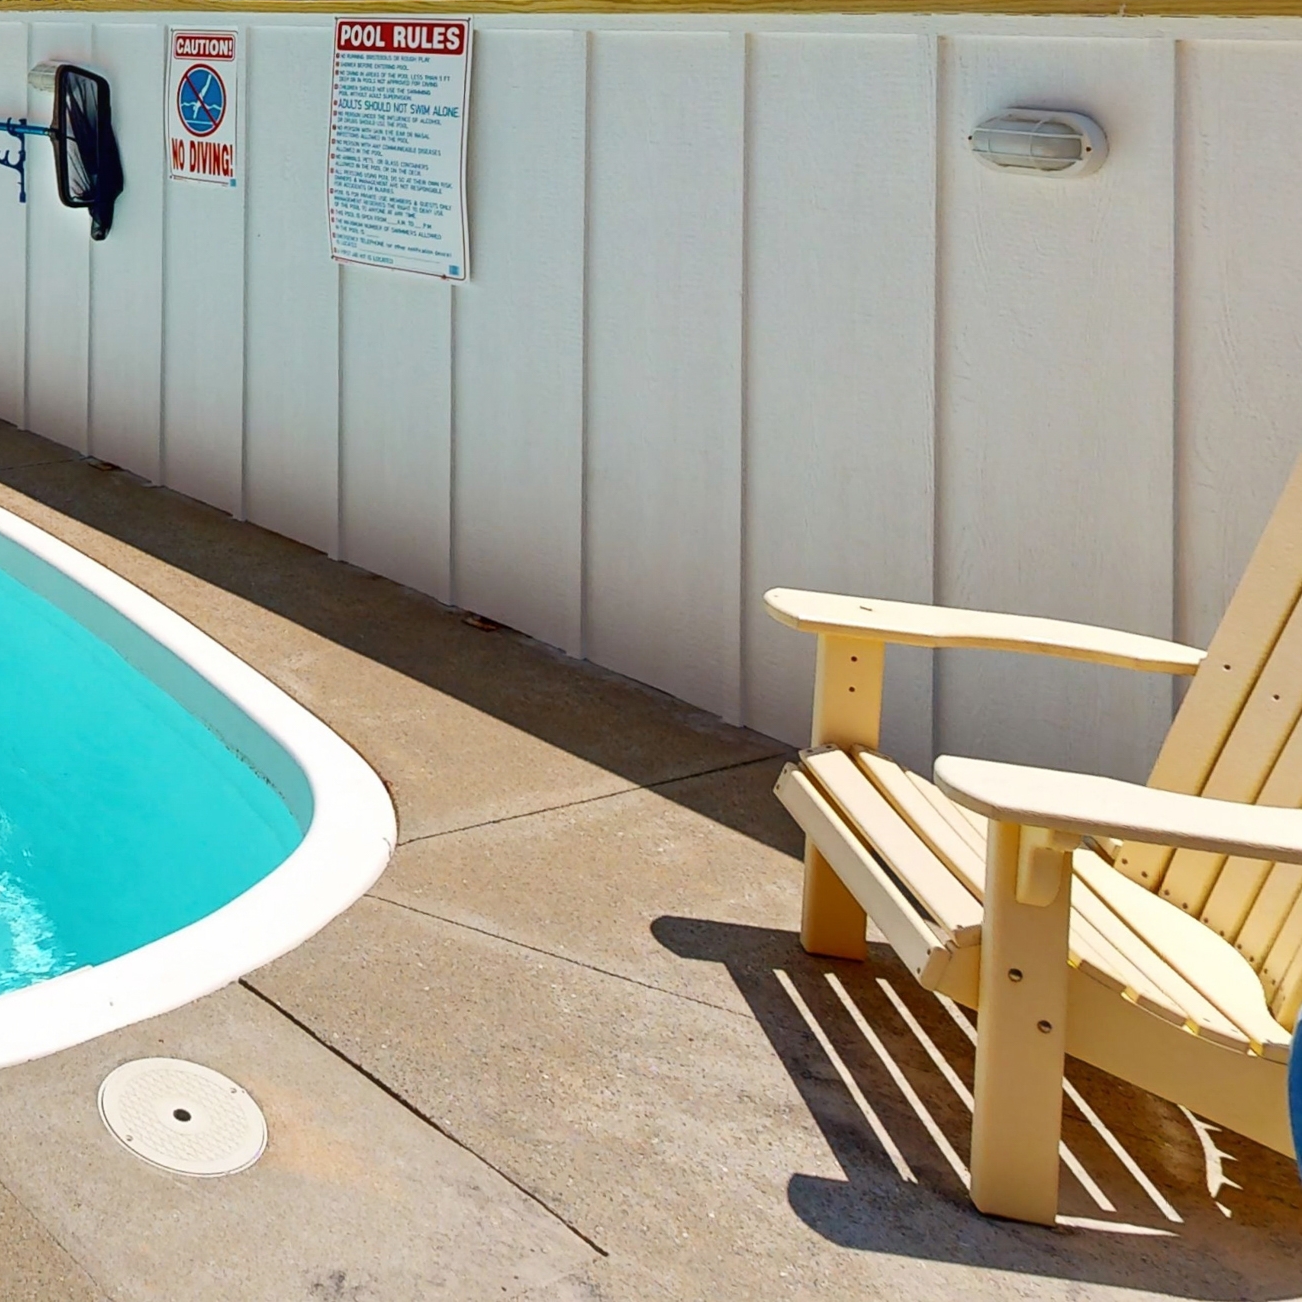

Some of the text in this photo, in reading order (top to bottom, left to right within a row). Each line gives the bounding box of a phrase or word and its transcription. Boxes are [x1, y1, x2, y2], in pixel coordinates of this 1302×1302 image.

[176, 38, 232, 56] CAUTION!
[340, 24, 460, 50] POOL RULES
[338, 98, 459, 117] ADULTS SHOULD NOT SWIM ALONE
[172, 138, 233, 177] NO DIVING!
